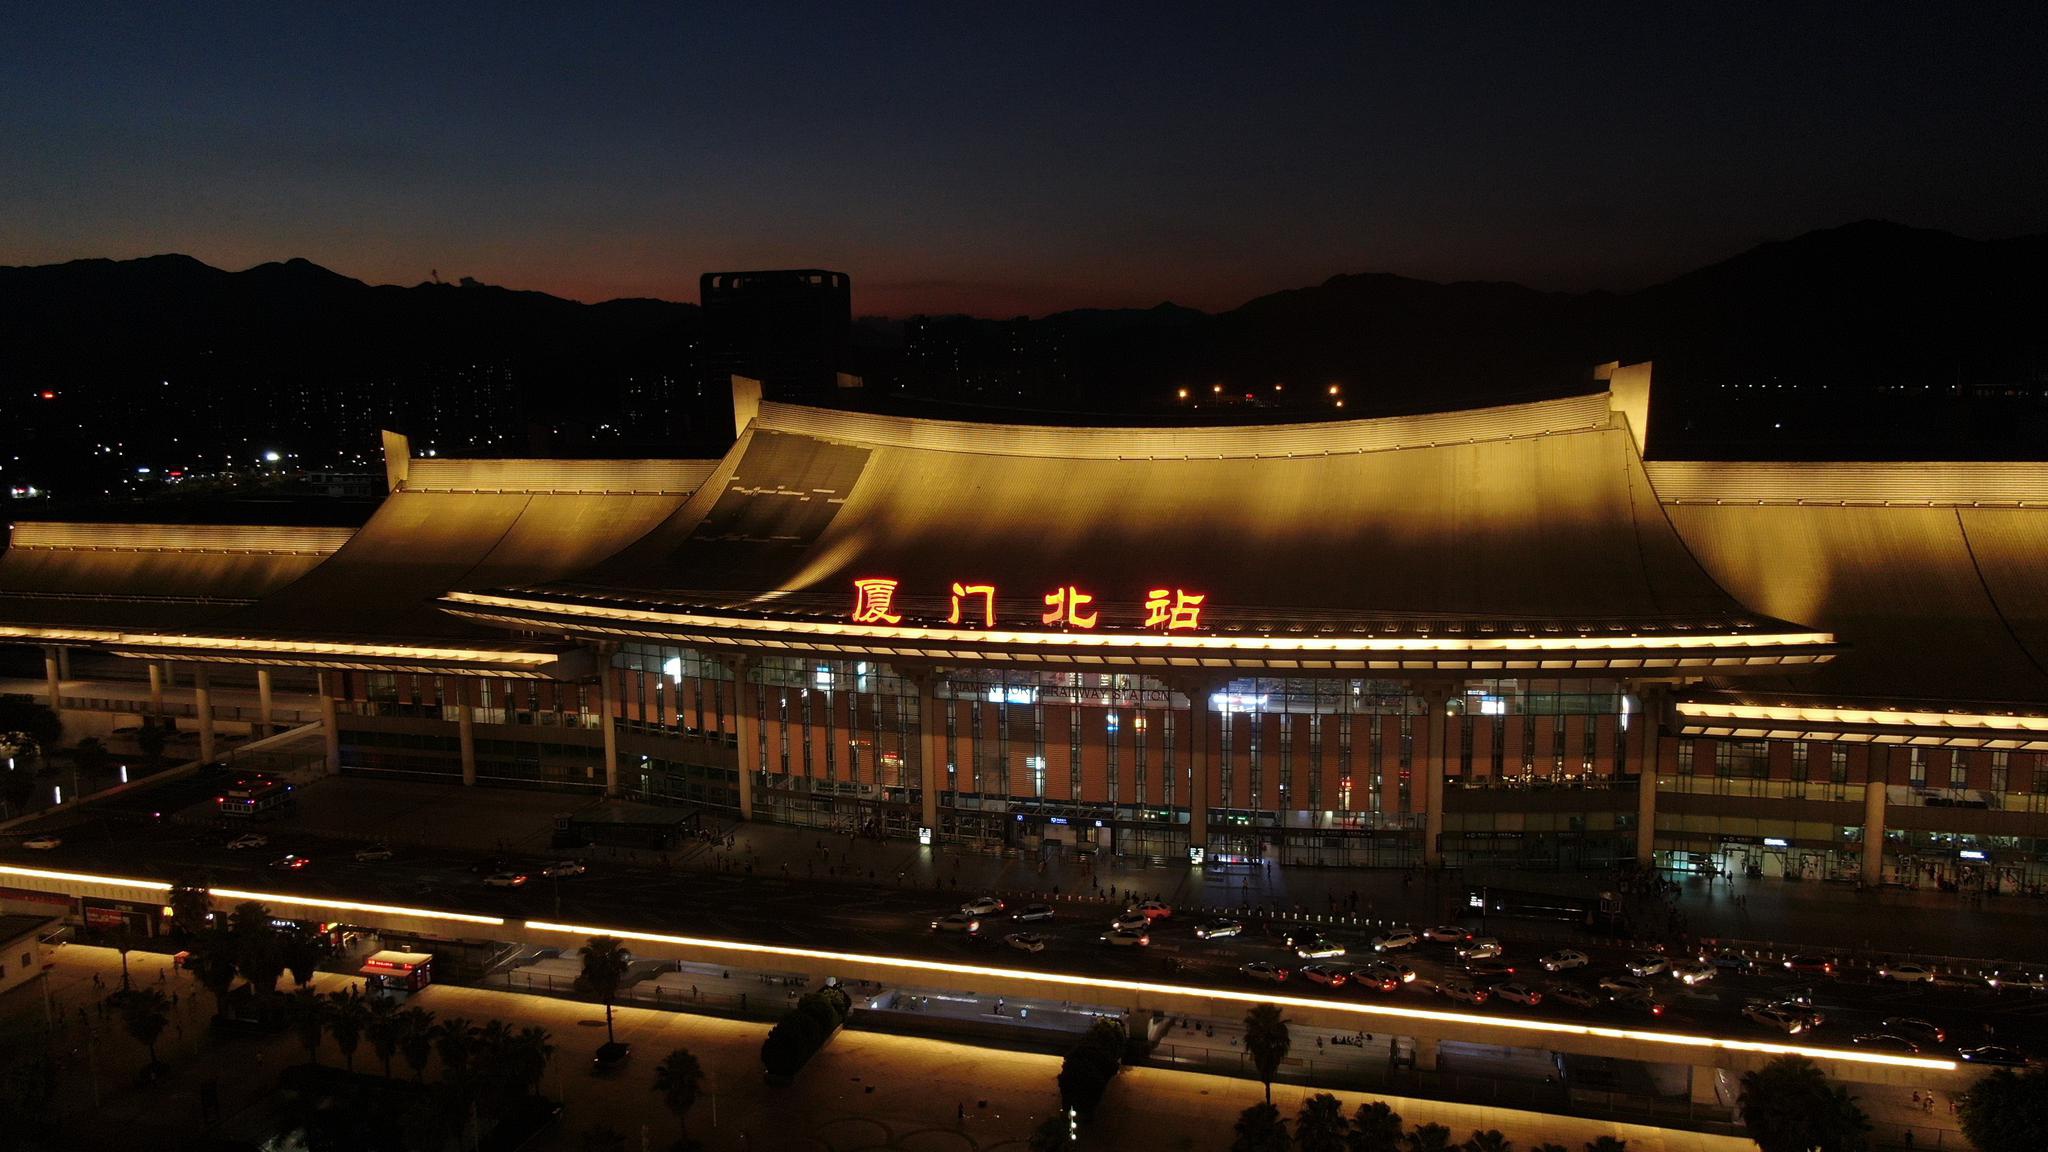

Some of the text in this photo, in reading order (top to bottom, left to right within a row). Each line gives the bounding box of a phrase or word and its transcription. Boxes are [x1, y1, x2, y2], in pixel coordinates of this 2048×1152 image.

[852, 579, 1204, 630] 厦门北站
[1051, 687, 1107, 699] RAILWAY
[1112, 689, 1169, 701] STATION
